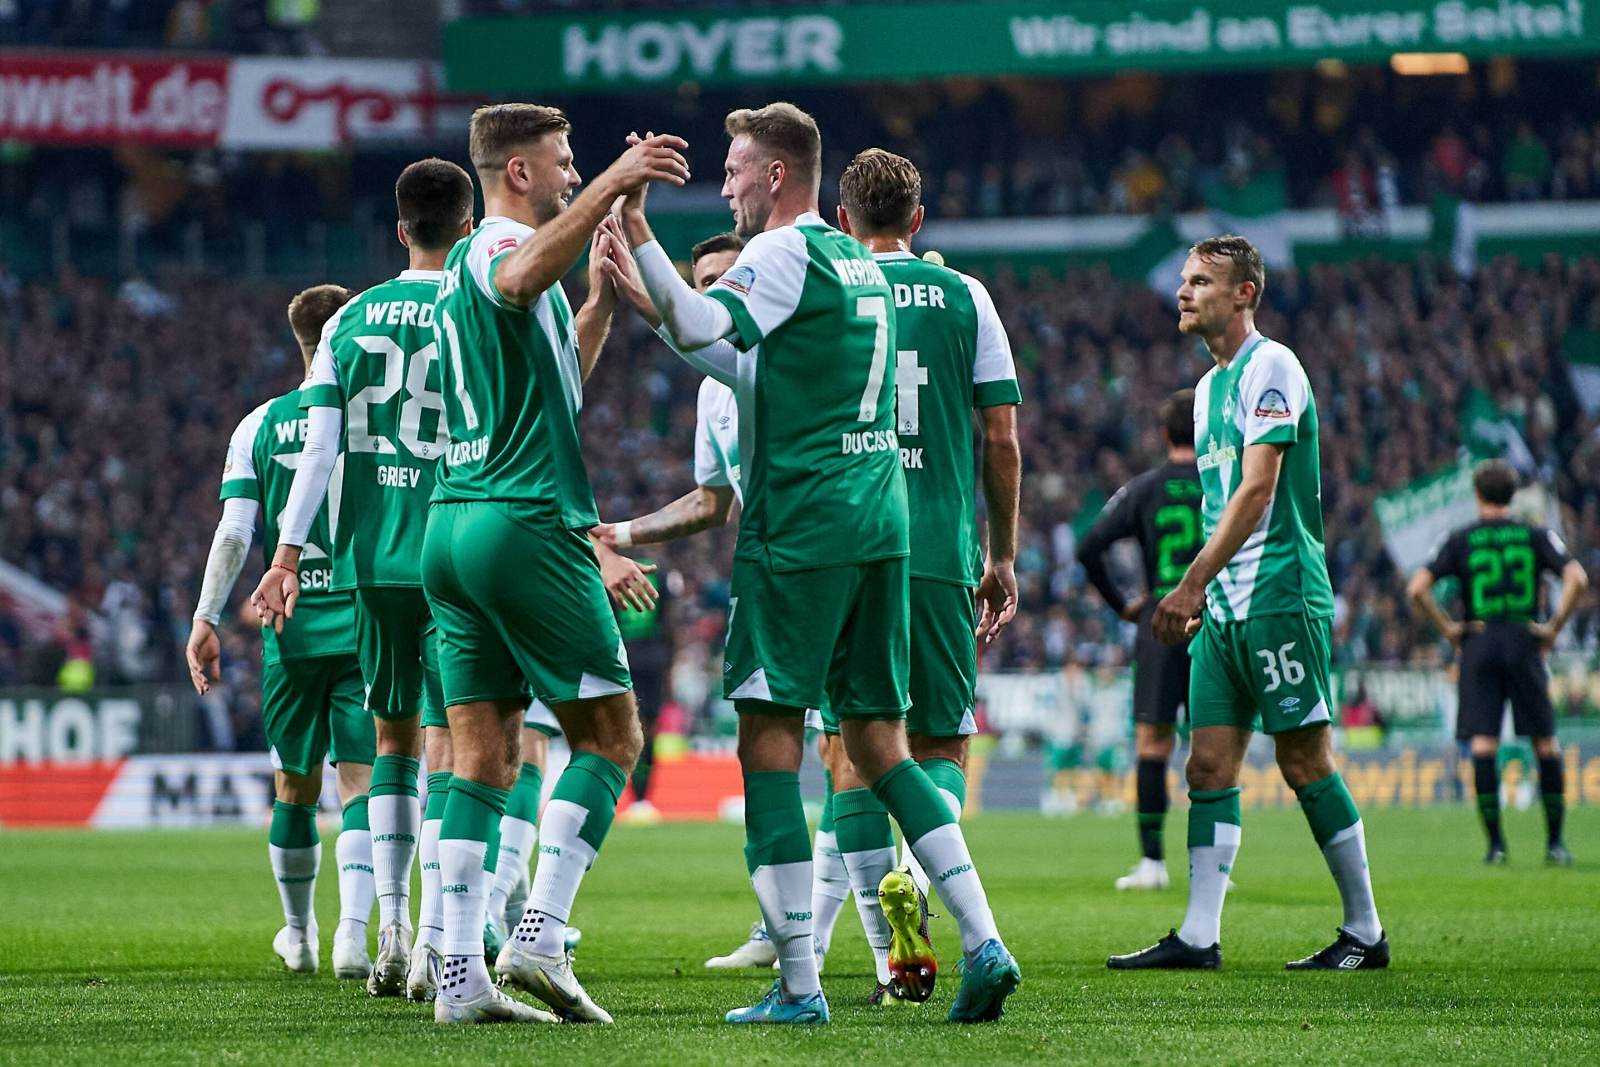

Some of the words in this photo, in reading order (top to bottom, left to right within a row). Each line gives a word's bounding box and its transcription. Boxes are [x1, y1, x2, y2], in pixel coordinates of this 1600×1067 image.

[563, 16, 843, 80] HOYER
[1010, 16, 1095, 56] Wir
[1104, 10, 1209, 53] sind
[1217, 18, 1280, 50] an
[1287, 6, 1423, 46] Eurer
[1434, 0, 1581, 42] Seite!
[365, 302, 435, 328] WERD
[857, 297, 887, 422] 7
[348, 336, 450, 460] 28
[1468, 545, 1536, 615] 23
[1256, 642, 1306, 692] 36
[0, 698, 142, 764] HOF
[373, 832, 415, 843] WERDER
